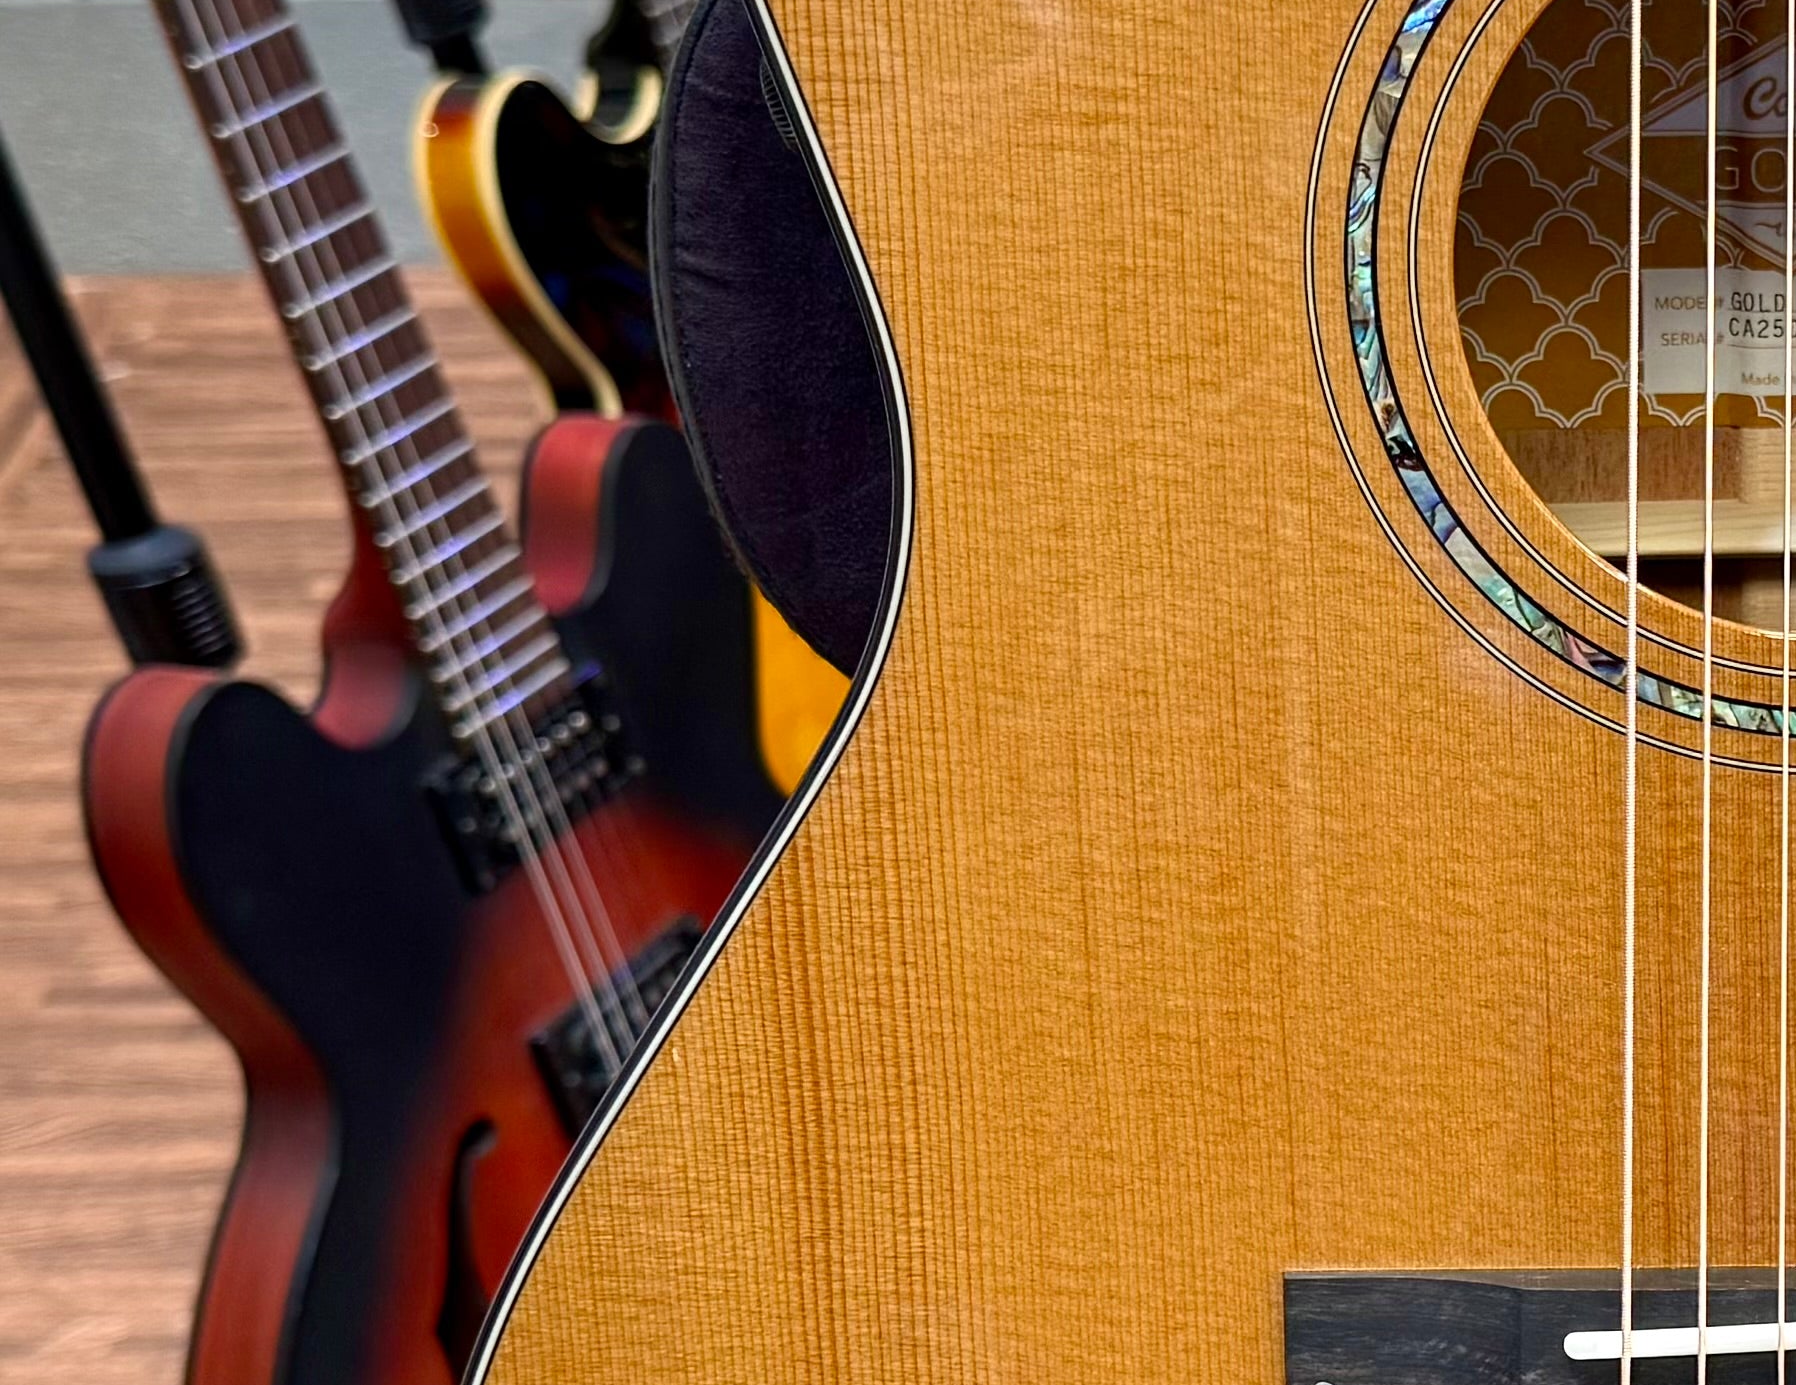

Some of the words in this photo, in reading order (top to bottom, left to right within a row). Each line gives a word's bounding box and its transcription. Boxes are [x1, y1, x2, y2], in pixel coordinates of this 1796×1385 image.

[1655, 296, 1712, 310] MODE
[1730, 291, 1785, 313] GOLD
[1661, 332, 1712, 346] SERIA
[1742, 372, 1780, 385] Made
